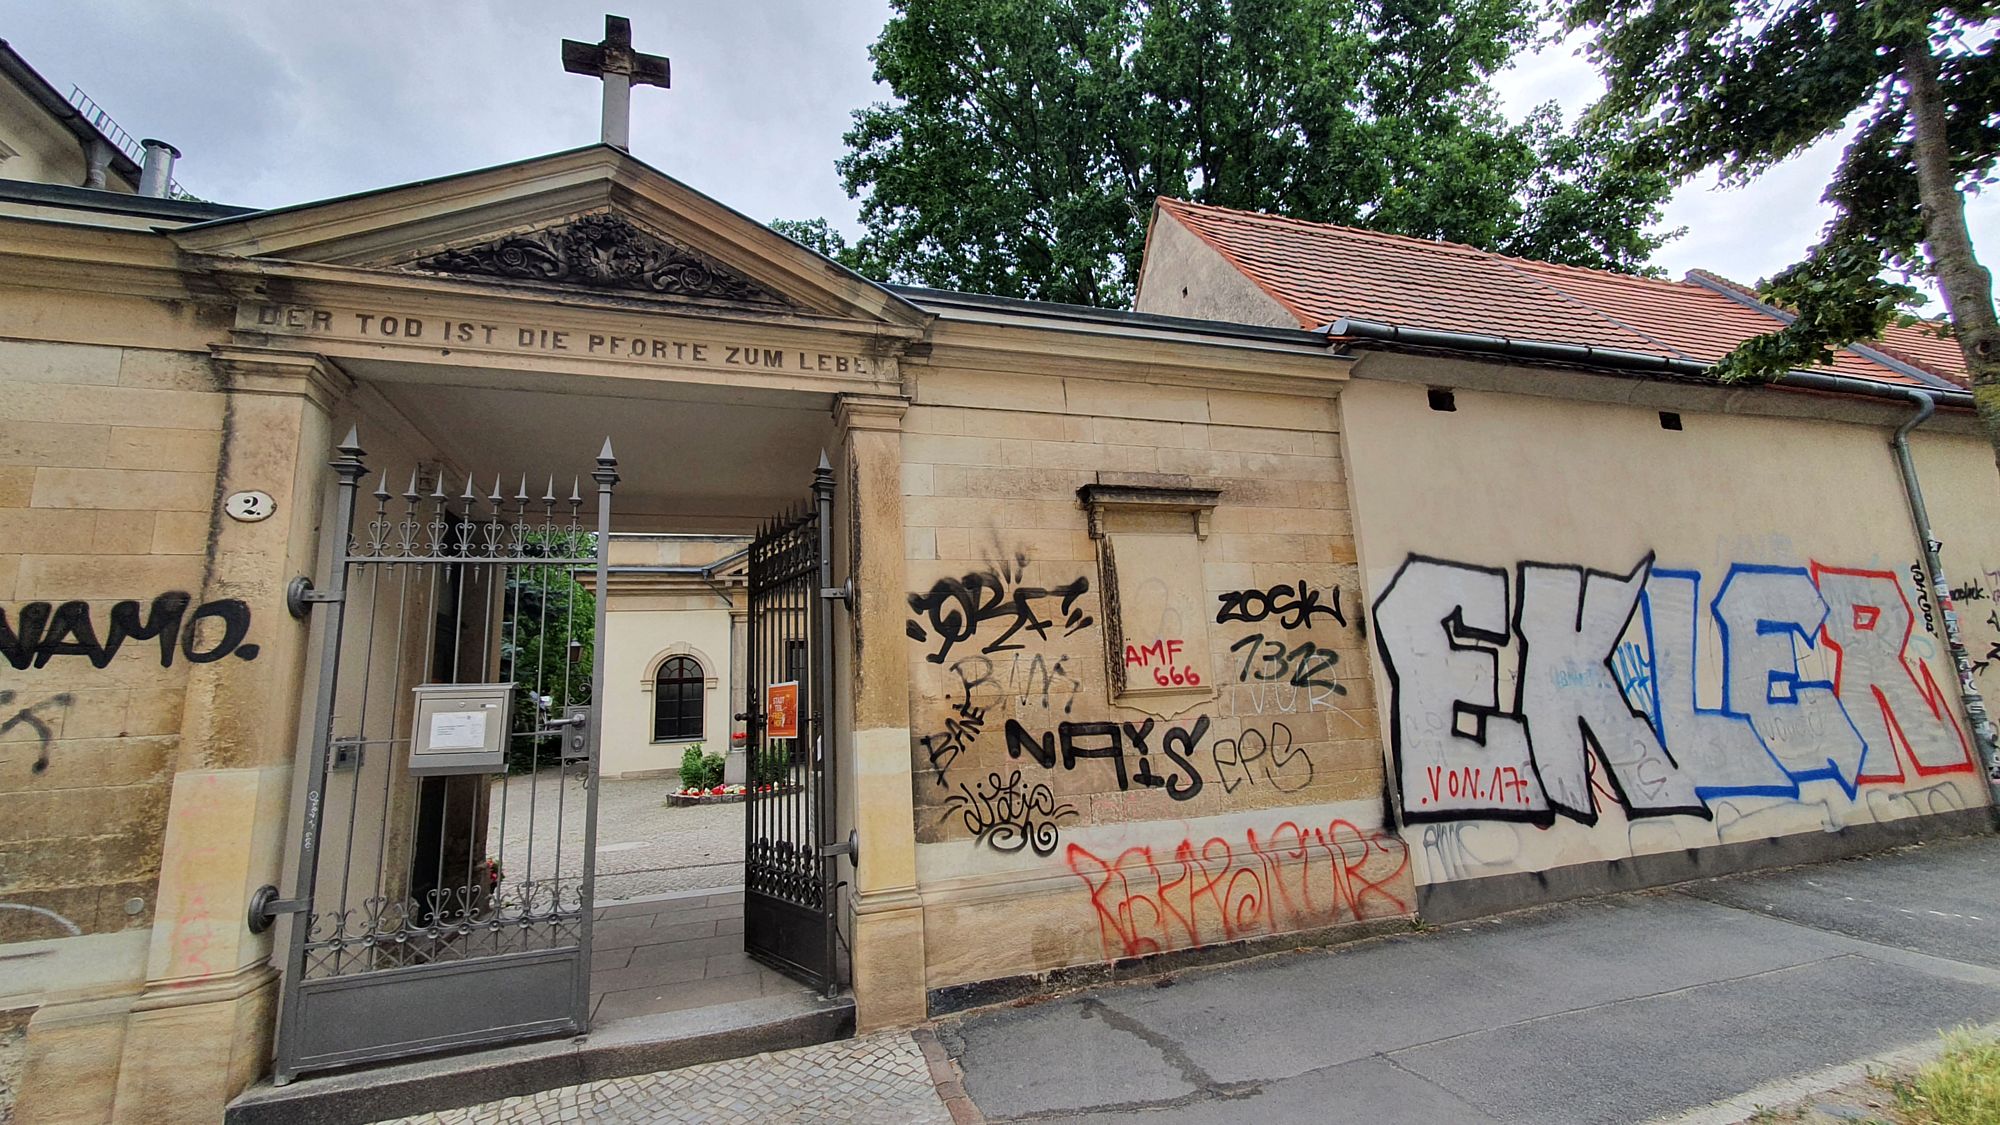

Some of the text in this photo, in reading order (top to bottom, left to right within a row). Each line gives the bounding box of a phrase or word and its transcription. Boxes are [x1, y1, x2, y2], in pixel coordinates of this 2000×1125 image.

[258, 304, 333, 331] DER
[355, 313, 423, 337] TOD
[443, 321, 498, 344] IST
[518, 327, 569, 349] DIE
[588, 334, 707, 362] PFORTE
[725, 346, 783, 368] ZUM
[1125, 639, 1184, 668] AMF
[1153, 665, 1201, 687] 666
